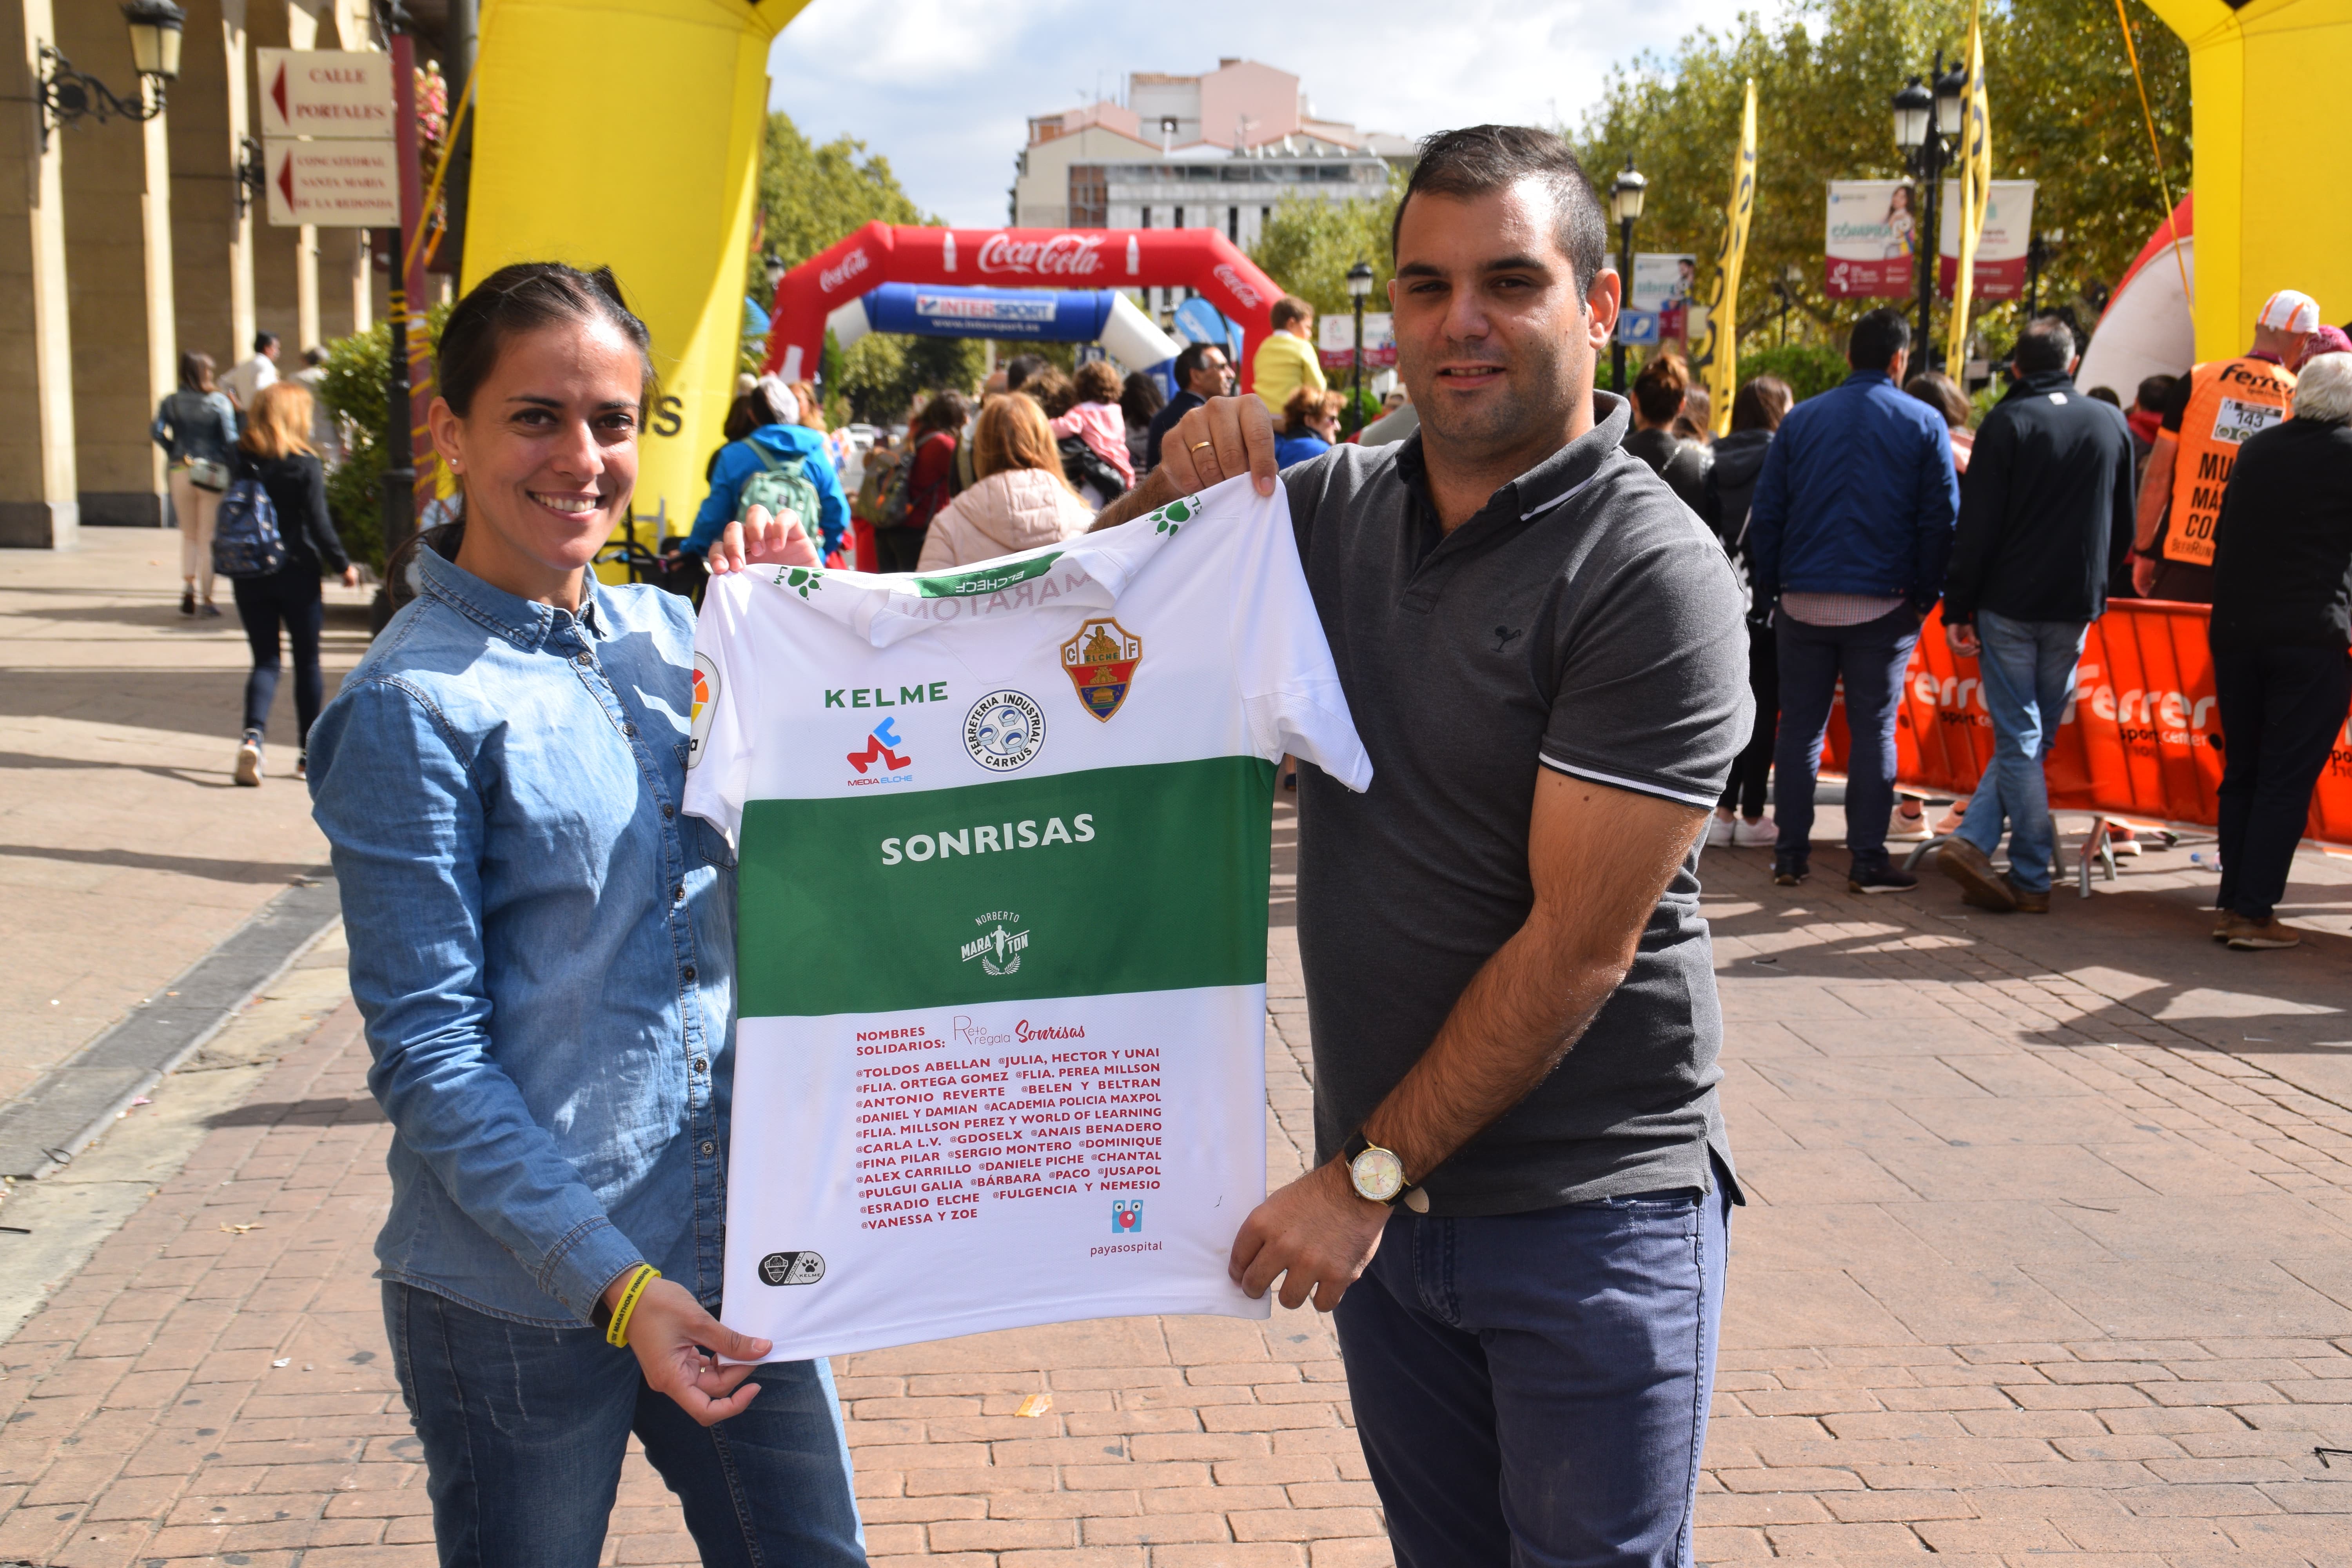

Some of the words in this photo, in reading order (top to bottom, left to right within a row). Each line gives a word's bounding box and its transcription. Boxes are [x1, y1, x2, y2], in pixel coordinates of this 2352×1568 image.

[309, 68, 367, 83] CALLE
[296, 103, 386, 119] PORTALES
[297, 156, 385, 167] CONCATEDRAL
[301, 178, 340, 188] SANTA
[344, 178, 385, 188] MARIA
[294, 198, 310, 210] DE
[315, 198, 332, 209] LA
[335, 199, 394, 210] REDONDA
[977, 233, 1106, 274] Coca-Cola
[819, 247, 869, 293] Coca-Cola
[940, 301, 1048, 320] INTERSPORT
[931, 319, 1041, 332] www.intersport.es
[2236, 411, 2264, 428] 143
[2198, 452, 2234, 483] MU
[2190, 482, 2220, 512] MÁ
[2185, 513, 2213, 539] CO
[1067, 648, 1076, 662] C
[1128, 642, 1136, 657] F
[1085, 652, 1118, 662] ELCHE
[825, 681, 948, 708] KELME
[2060, 664, 2217, 730] Ferrer
[967, 697, 999, 756] FERRETERIA
[1004, 693, 1041, 744] INDUSTRIAL
[1941, 710, 1977, 728] sport
[985, 747, 1033, 767] CARRUS
[848, 778, 880, 786] MEDIA
[880, 775, 913, 784] ELCHE
[881, 813, 1095, 865] SONRISAS
[975, 911, 1020, 926] NORBERTO
[961, 935, 992, 959] MARA
[1007, 934, 1028, 954] TON
[857, 1027, 925, 1042] NOMBRES
[953, 1015, 987, 1045] Reto
[974, 1034, 1011, 1046] regala
[1015, 1019, 1085, 1043] Sonrisas
[857, 1039, 945, 1056] SOLIDARIOS:
[856, 1064, 920, 1078] @TOLDOS
[925, 1058, 990, 1072] ABELLAN
[997, 1055, 1047, 1069] @JULIA,
[1052, 1051, 1107, 1063] HECTOR
[1111, 1050, 1120, 1059] Y
[1125, 1048, 1159, 1058] UNAI
[856, 1082, 896, 1093] @FLIA.
[900, 1076, 957, 1089] ORTEGA
[961, 1072, 1009, 1084] GOMEZ
[1016, 1069, 1055, 1079] @FLIA.
[1059, 1066, 1100, 1077] PEREA
[1104, 1063, 1160, 1074] MILLSON
[856, 1093, 934, 1109] @ANTONIO
[943, 1087, 1005, 1100] REVERTE
[1022, 1083, 1072, 1094] @BELEN
[1080, 1081, 1089, 1091] Y
[1098, 1078, 1160, 1090] BELTRAN
[856, 1111, 909, 1124] @DANIEL
[913, 1109, 921, 1118] Y
[926, 1104, 977, 1117] DAMIAN
[984, 1099, 1056, 1112] @ACADEMIA
[1059, 1095, 1107, 1107] POLICIA
[1111, 1093, 1161, 1103] MAXPOL
[856, 1127, 896, 1139] @FLIA.
[900, 1120, 959, 1134] MILLSON
[964, 1117, 1004, 1129] PEREZ
[1009, 1116, 1017, 1125] Y
[1021, 1112, 1070, 1124] WORLD
[1074, 1111, 1091, 1120] OF
[1095, 1107, 1161, 1119] LEARNING
[856, 1140, 913, 1154] @CARLA
[918, 1137, 941, 1148] L.V.
[950, 1130, 1023, 1144] @GDOSELX
[1031, 1126, 1081, 1138] @ANAIS
[1086, 1122, 1162, 1134] BENADERO
[856, 1157, 897, 1169] @FINA
[901, 1152, 940, 1164] PILAR
[947, 1147, 1002, 1159] @SERGIO
[1006, 1141, 1072, 1154] MONTERO
[1079, 1137, 1161, 1148] @DOMINIQUE
[856, 1171, 901, 1184] @ALEX
[905, 1164, 971, 1179] CARRILLO
[978, 1158, 1041, 1171] @DANIELE
[1046, 1154, 1084, 1166] PICHE
[1091, 1151, 1161, 1162] @CHANTAL
[858, 1184, 916, 1199] @PULGUI
[921, 1180, 963, 1192] GALIA
[971, 1172, 1042, 1187] @BÁRBARA
[1049, 1169, 1090, 1180] @PACO
[1098, 1166, 1161, 1179] @JUSAPOL
[860, 1198, 929, 1214] @ESRADIO
[937, 1193, 979, 1206] ELCHE
[993, 1184, 1077, 1200] @FULGENCIA
[1085, 1183, 1093, 1192] Y
[1100, 1180, 1160, 1191] NEMESIO
[861, 1213, 933, 1230] @VANESSA
[937, 1211, 946, 1221] Y
[951, 1209, 977, 1220] ZOE
[1091, 1241, 1162, 1256] payasospital
[786, 1263, 799, 1282] OFFICIAL
[613, 1293, 633, 1333] MARATHON
[630, 1268, 651, 1293] FINISHER
